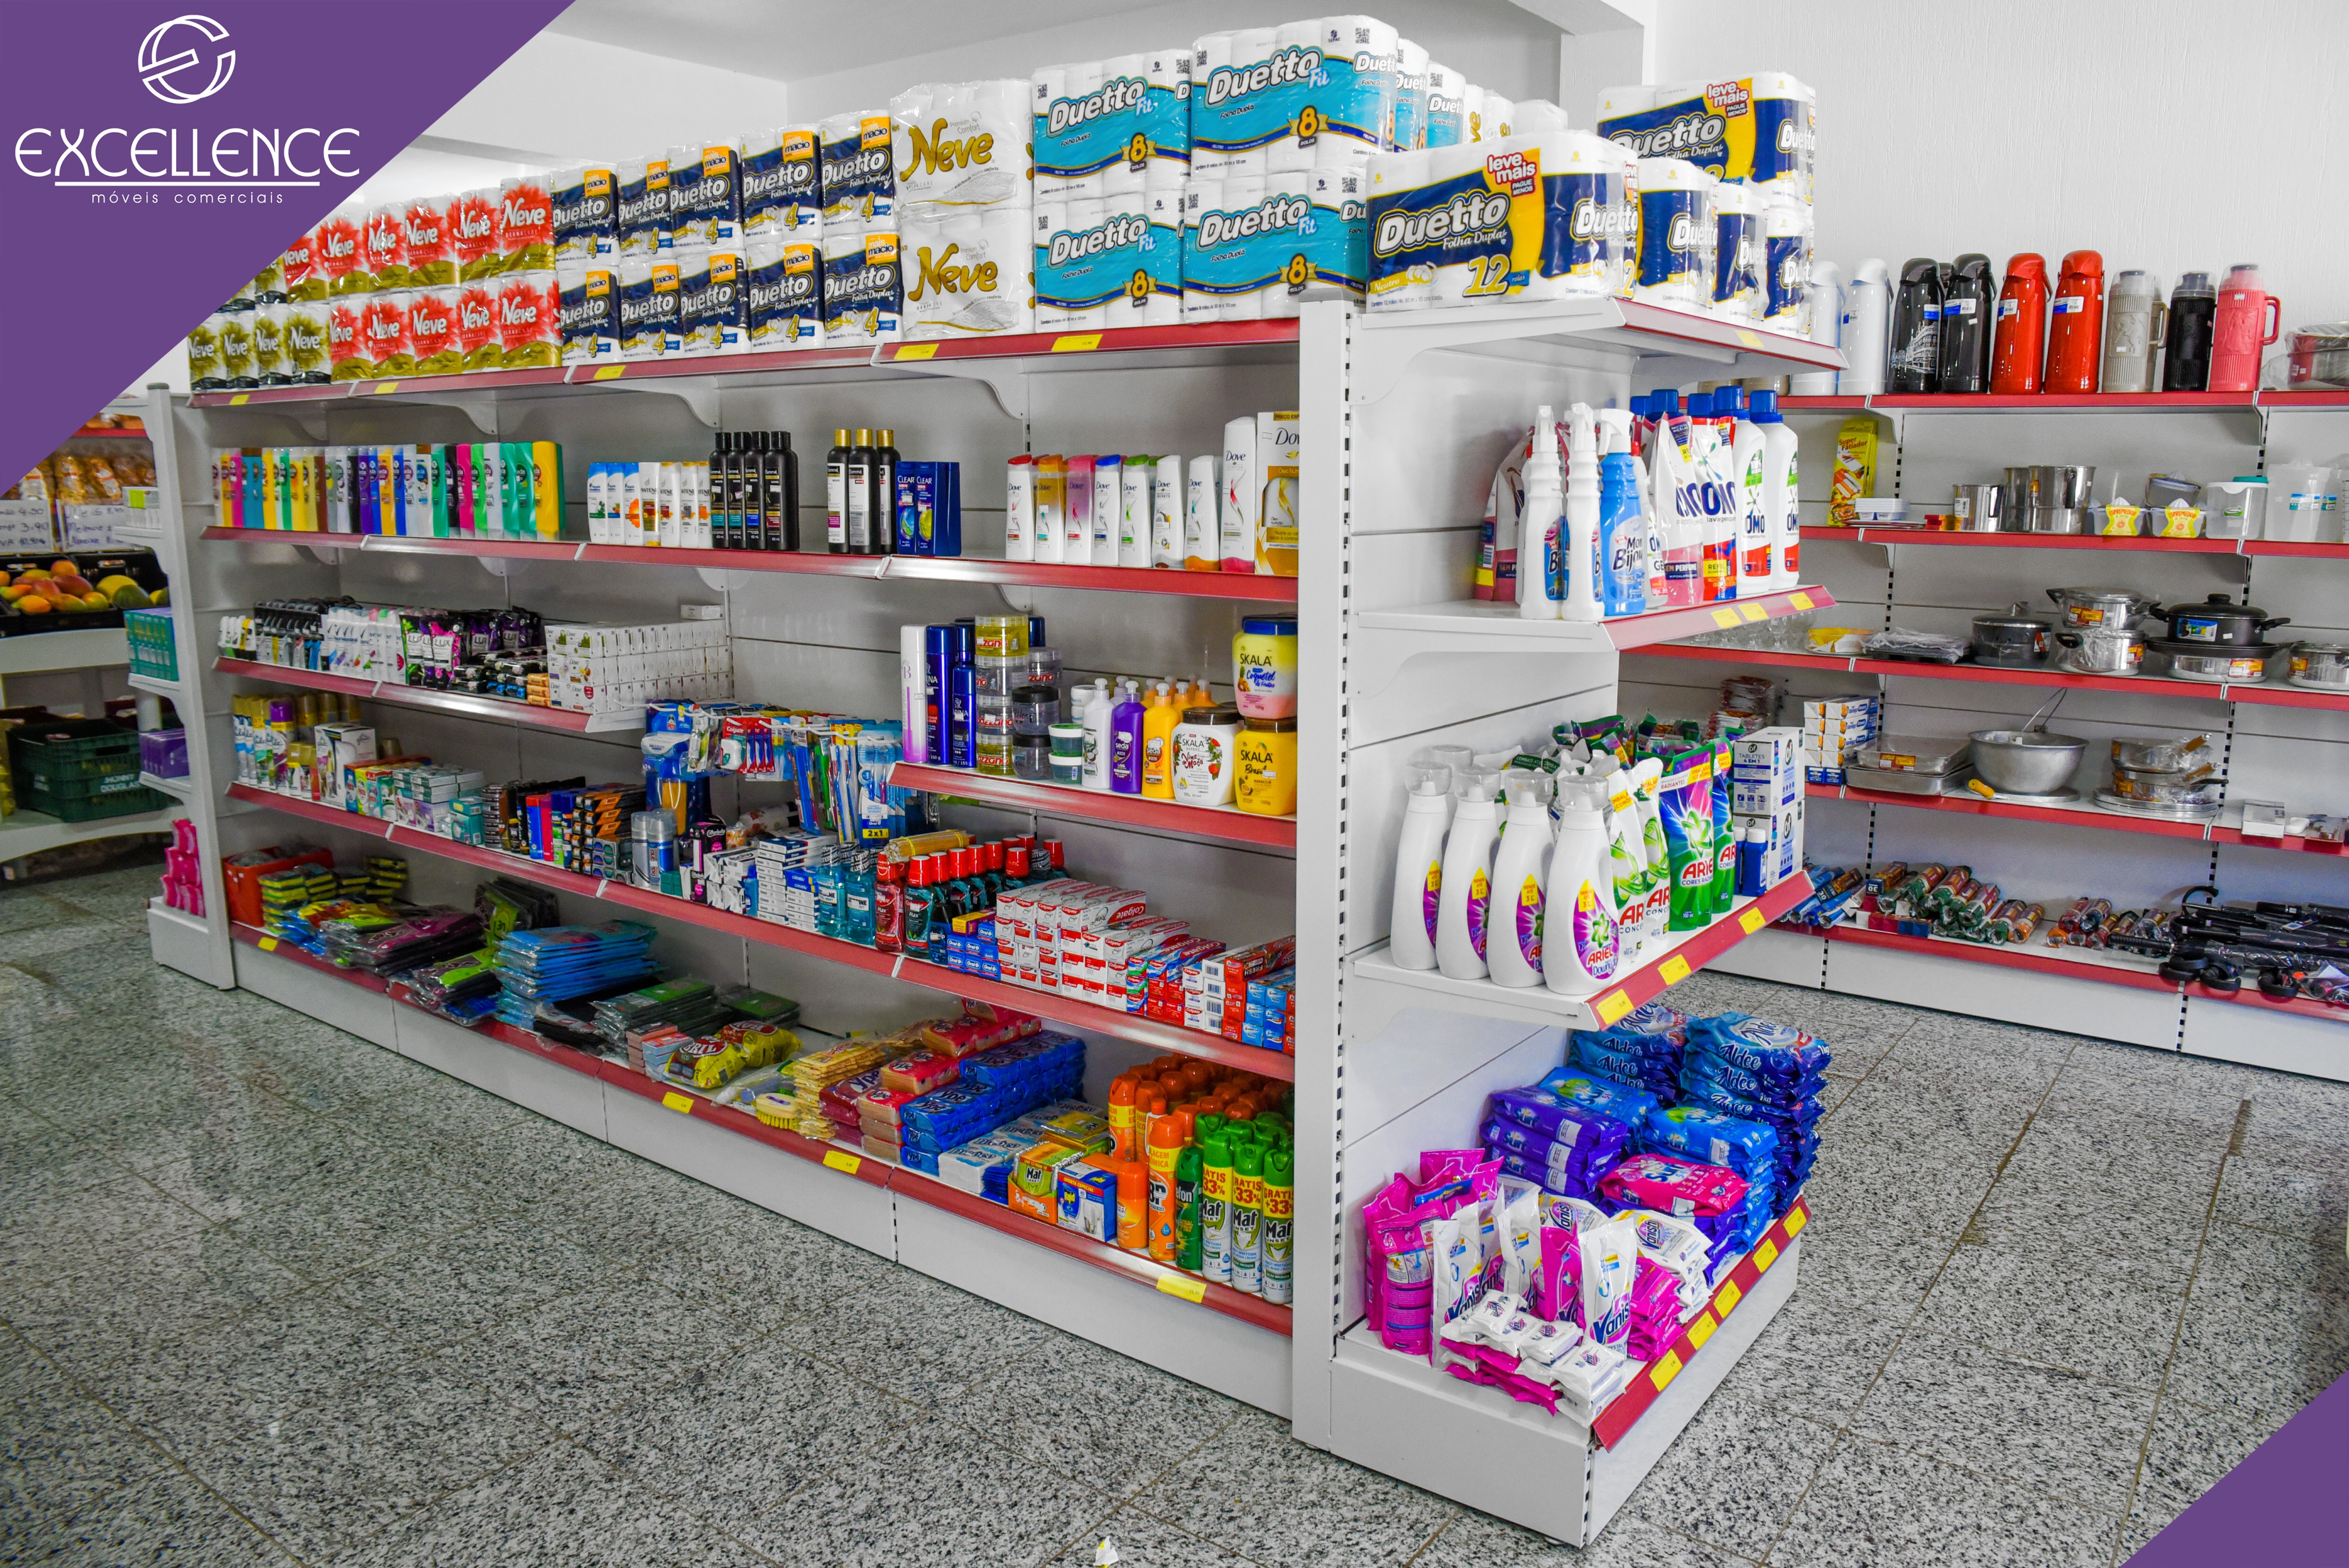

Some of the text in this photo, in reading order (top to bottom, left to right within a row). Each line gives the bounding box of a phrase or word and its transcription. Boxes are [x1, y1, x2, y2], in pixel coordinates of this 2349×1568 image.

[1208, 50, 1331, 105] Duetto Fit
[1708, 81, 1737, 98] leve
[1714, 89, 1748, 107] mais
[1049, 80, 1153, 134] Duetto Fit
[1220, 104, 1254, 119] Folha Dupla
[1726, 103, 1746, 112] PAGUE
[1728, 108, 1748, 117] MENOS
[957, 124, 980, 134] Comfort
[1297, 105, 1318, 138] 8
[785, 136, 801, 145] mais
[863, 127, 887, 140] macio
[1075, 133, 1091, 143] Dupla
[785, 141, 810, 153] macio
[900, 118, 994, 182] Neve
[1129, 132, 1148, 163] 8
[1488, 153, 1522, 170] leve
[1496, 161, 1536, 183] mais
[744, 164, 811, 198] Duetto
[1512, 179, 1534, 189] PAGUE
[671, 178, 725, 210] Duetto
[1512, 185, 1534, 196] MENOS
[553, 198, 606, 227] Duetto
[619, 193, 668, 222] Duetto
[861, 192, 874, 222] 4
[785, 203, 799, 230] 4
[1198, 197, 1317, 248] Duetto Fit
[1377, 193, 1506, 253] Duetto
[1050, 217, 1157, 265] Duetto Fit
[1443, 230, 1504, 250] Folha Dupla
[869, 244, 894, 256] macio
[966, 251, 986, 261] Comfort
[1228, 249, 1245, 259] Dupla
[786, 255, 810, 266] macio
[1287, 253, 1308, 285] 8
[655, 273, 676, 284] macio
[908, 243, 998, 301] Neve
[1464, 254, 1526, 297] 12 rolos
[1131, 269, 1149, 299] 8
[1374, 278, 1400, 292] Neutro
[786, 314, 799, 342] 4
[189, 337, 213, 358] Neve
[224, 334, 248, 356] Neve
[256, 329, 278, 351] Neve
[1839, 437, 1856, 446] Super
[1842, 440, 1868, 451] Fatiador
[1157, 480, 1170, 488] Dove
[2169, 510, 2197, 519] ESPREMEDOR
[1746, 515, 1765, 534] OMO
[1627, 536, 1643, 549] Mon
[1613, 548, 1643, 573] Bijou
[1707, 562, 1725, 571] REFIL
[1240, 653, 1272, 667] SKALA
[1246, 669, 1275, 681] Coquetel
[1182, 739, 1204, 748] SKALA
[1749, 744, 1757, 753] Cif
[1241, 750, 1273, 764] SKALA
[1516, 756, 1533, 764] COMBATE
[1245, 764, 1267, 775] Brasil
[1661, 779, 1685, 789] RADIANTES
[1683, 861, 1714, 880] ARIE
[1682, 877, 1700, 886] CORES
[1588, 949, 1613, 966] ARIEL
[1245, 965, 1263, 976] FRESH
[1593, 960, 1614, 977] Downy
[682, 1041, 717, 1054] BRIL
[1719, 1042, 1762, 1070] Aldee
[1820, 1044, 1831, 1056] 1kg
[1598, 1055, 1638, 1077] Aldee
[1718, 1066, 1757, 1092] Aldee
[1711, 1092, 1753, 1116] Aldee
[1760, 1092, 1772, 1104] 1kg
[1514, 1107, 1540, 1127] Surf
[1504, 1131, 1527, 1153] Surf
[1664, 1133, 1689, 1151] Surf
[1027, 1167, 1041, 1179] Mat
[1646, 1163, 1689, 1182] Surf
[1064, 1177, 1094, 1193] OFERTA ESPECIAL
[1065, 1192, 1075, 1202] Raid
[1203, 1199, 1222, 1217] Mat
[1234, 1208, 1258, 1227] Mat
[1266, 1220, 1292, 1239] Mat
[1642, 1219, 1662, 1250] Vanish
